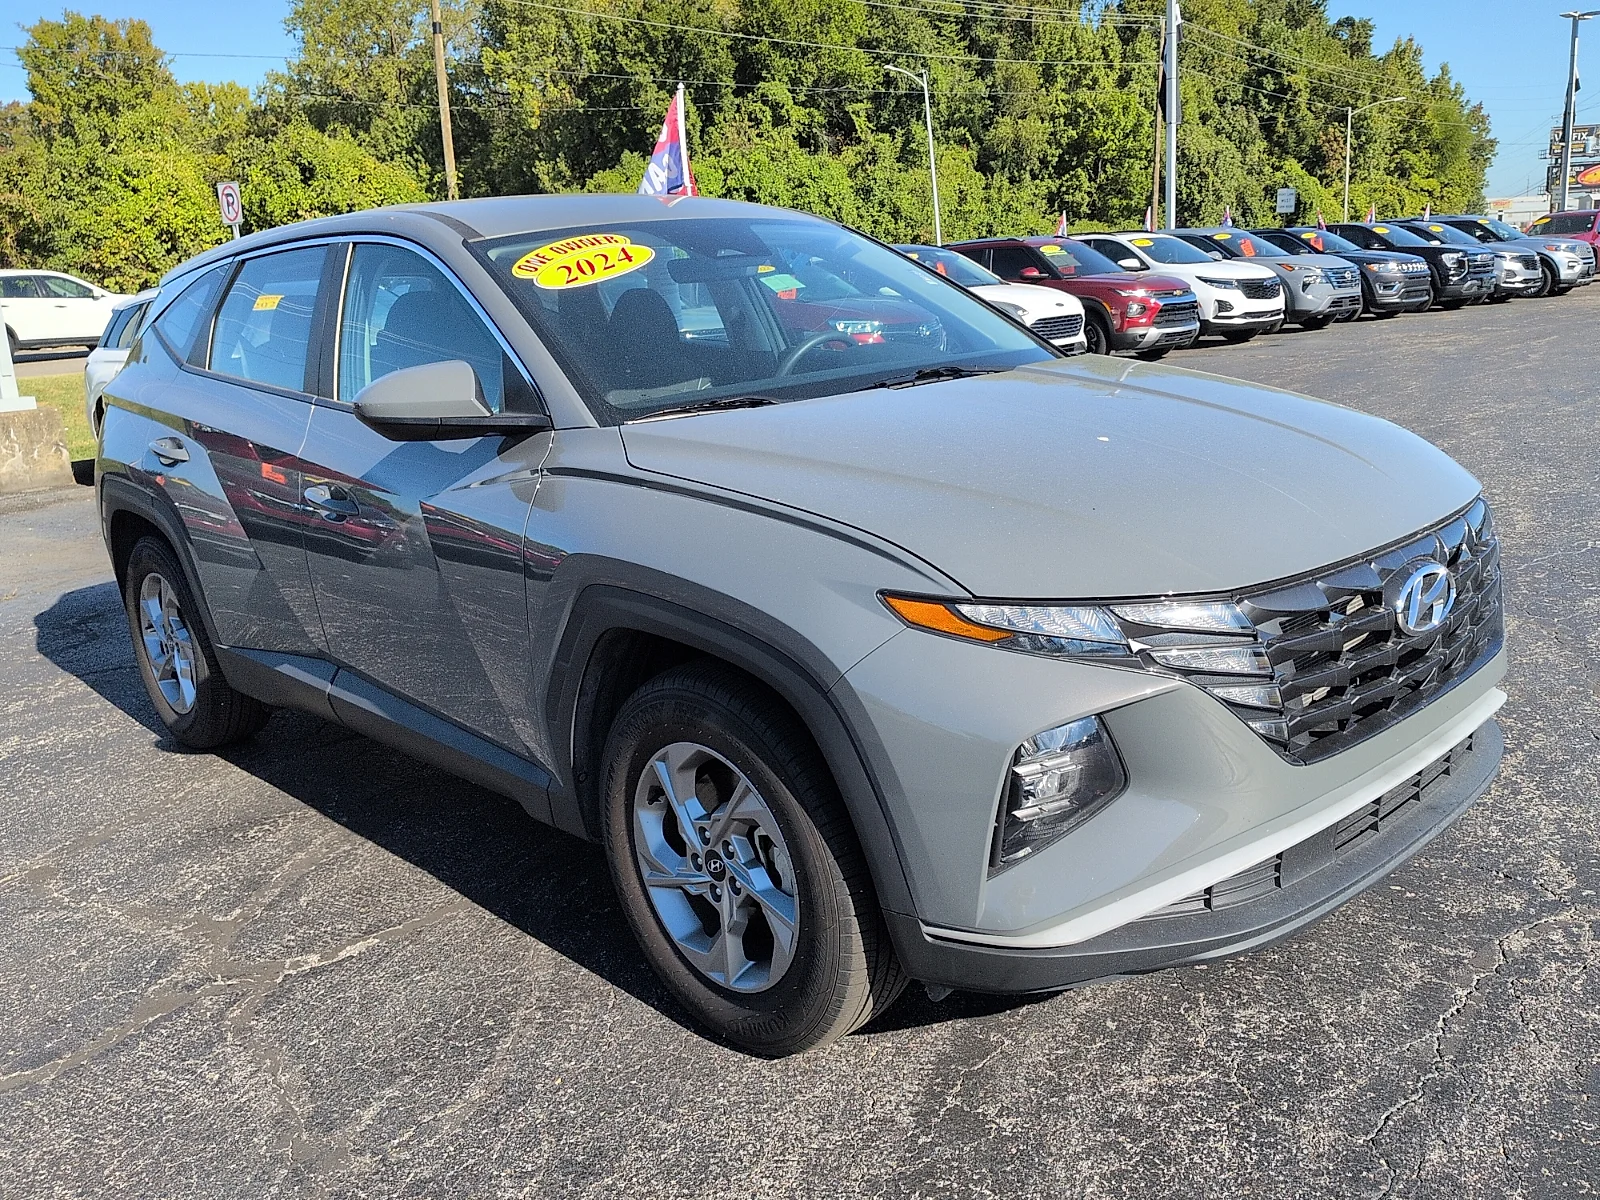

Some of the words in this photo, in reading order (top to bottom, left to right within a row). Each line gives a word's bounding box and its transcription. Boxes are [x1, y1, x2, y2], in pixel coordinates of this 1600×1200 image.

[1572, 132, 1588, 140] FIX
[517, 253, 554, 272] ONE
[549, 235, 619, 255] OWNER
[557, 247, 634, 284] 2024
